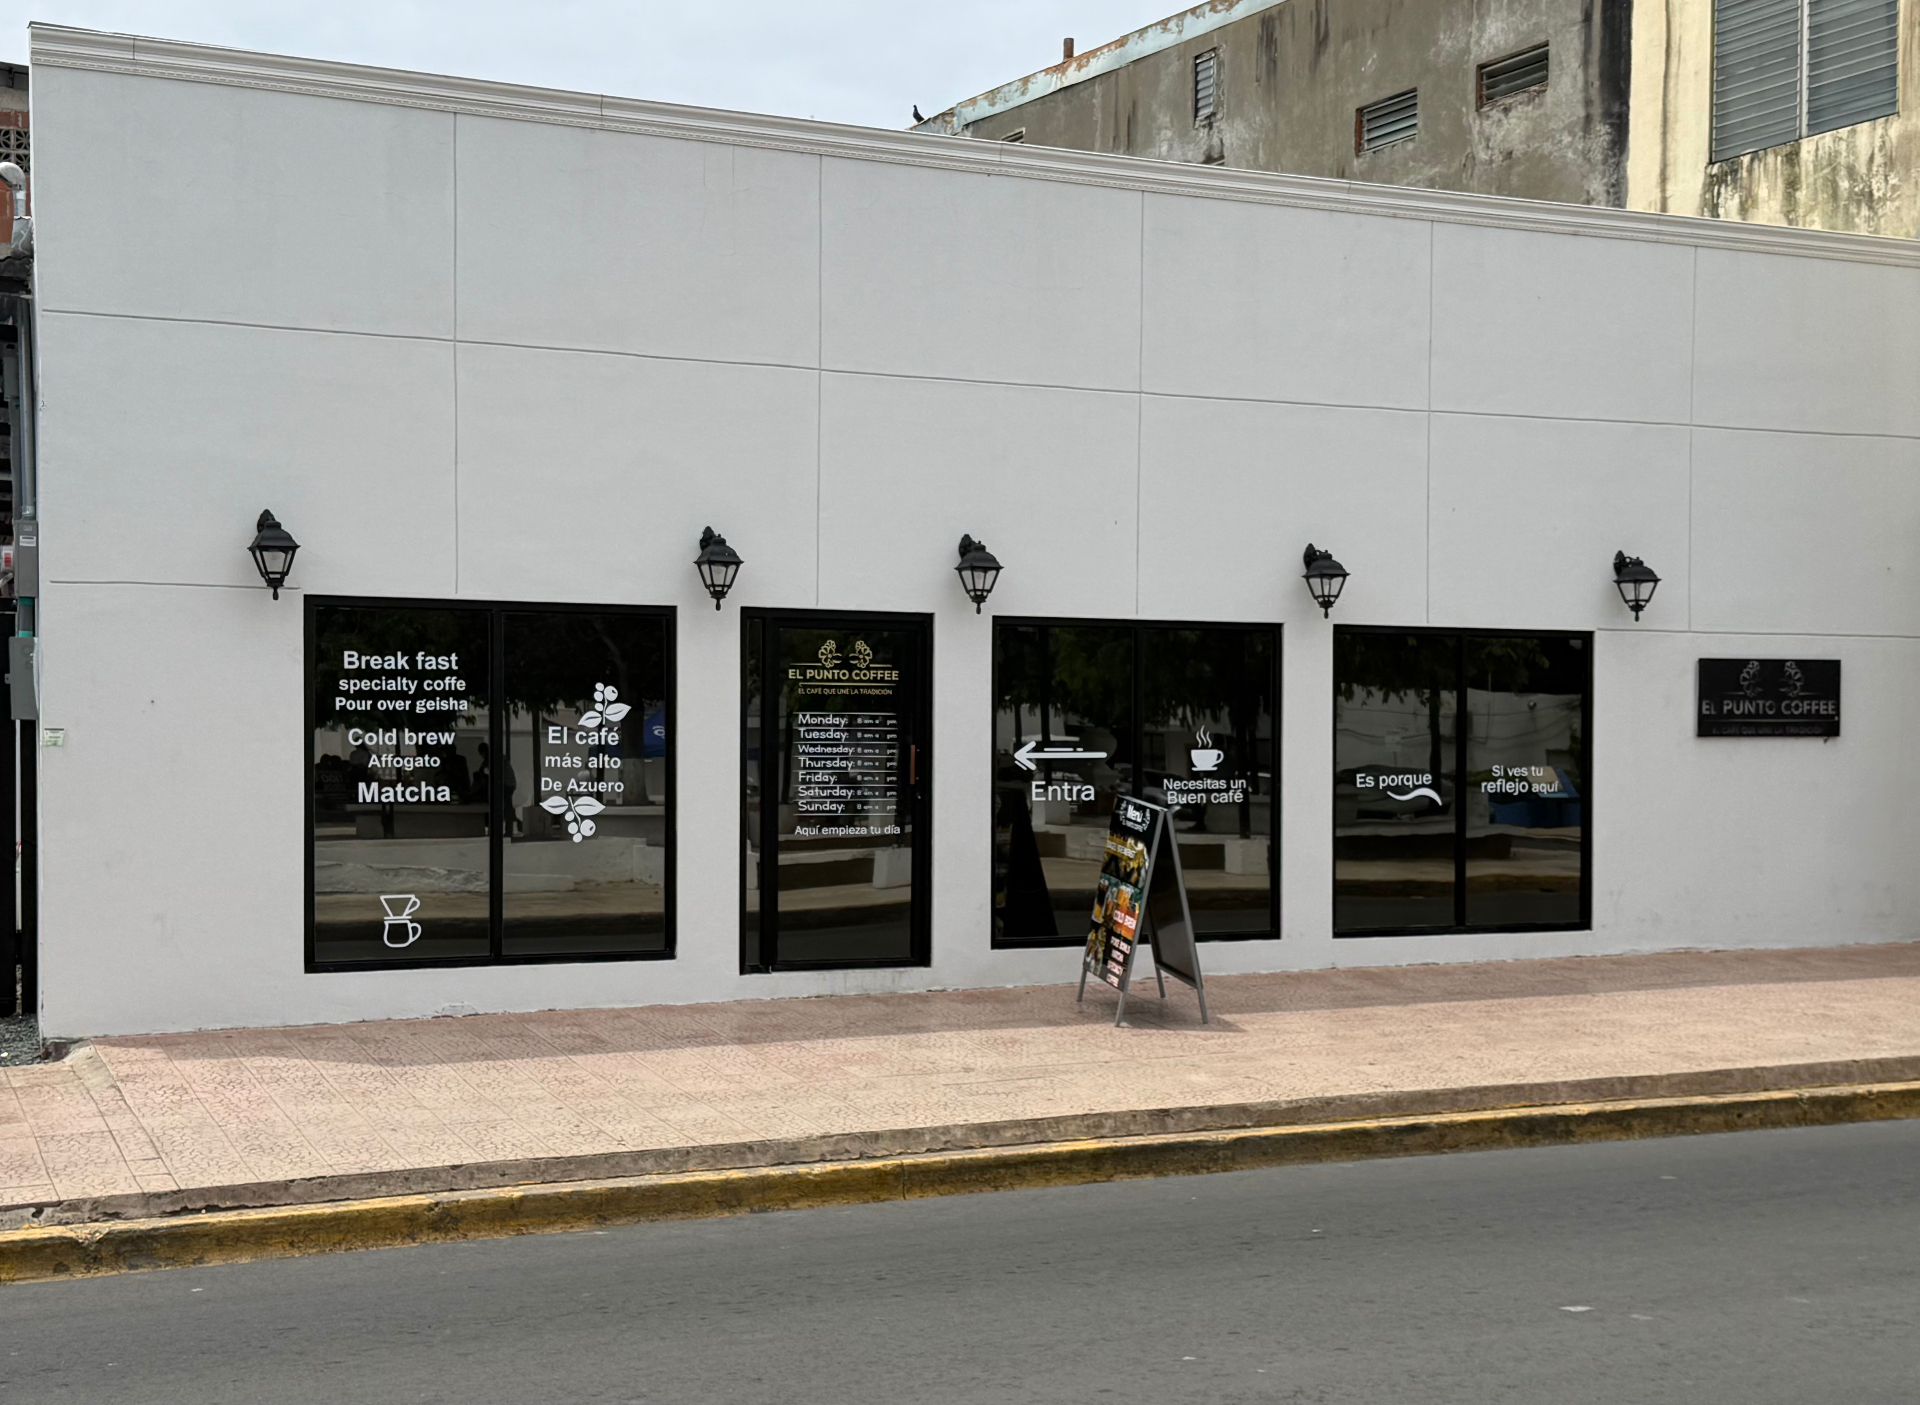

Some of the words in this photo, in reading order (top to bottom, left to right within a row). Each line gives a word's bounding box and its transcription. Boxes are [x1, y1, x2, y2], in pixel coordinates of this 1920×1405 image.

[344, 651, 409, 670] Break
[416, 652, 458, 670] fast
[789, 669, 803, 679] EL
[807, 670, 849, 679] PUNTO
[852, 670, 899, 680] COFFEE
[339, 677, 417, 694] specialty
[423, 678, 466, 691] coffe
[335, 698, 372, 710] Pour
[377, 700, 411, 710] over
[416, 698, 468, 713] geisha
[1702, 701, 1716, 714] EL
[1723, 700, 1776, 715] PUNTO
[1781, 700, 1836, 715] COFFEE
[798, 714, 848, 727] Monday:
[348, 728, 397, 745] Cold
[405, 729, 455, 745] brew
[548, 727, 568, 744] El
[575, 727, 619, 745] café
[798, 729, 849, 742] Tuesday:
[798, 745, 855, 755] Wednesday:
[368, 755, 440, 770] Affogato
[545, 753, 582, 768] más
[588, 754, 621, 769] alto
[798, 758, 855, 770] Thursday:
[798, 772, 837, 784] Friday:
[1492, 765, 1503, 777] Si
[1507, 767, 1528, 777] ves
[1531, 766, 1543, 777] tu
[541, 778, 562, 792] De
[567, 777, 624, 792] Azuero
[1163, 778, 1227, 790] Necesitas
[1230, 780, 1246, 790] un
[1356, 774, 1374, 788] Es
[1379, 773, 1432, 789] porque
[1481, 779, 1529, 795] reflejo
[1531, 782, 1559, 794] aquí
[358, 781, 451, 803] Matcha
[798, 786, 855, 799] Saturday:
[1031, 781, 1095, 802] Entra
[1168, 791, 1207, 805] Buen
[1210, 789, 1243, 804] café
[798, 800, 845, 813] Sunday:
[1127, 805, 1143, 822] Menú
[795, 826, 820, 836] Aquí
[822, 825, 867, 836] empieza
[884, 825, 900, 834] día
